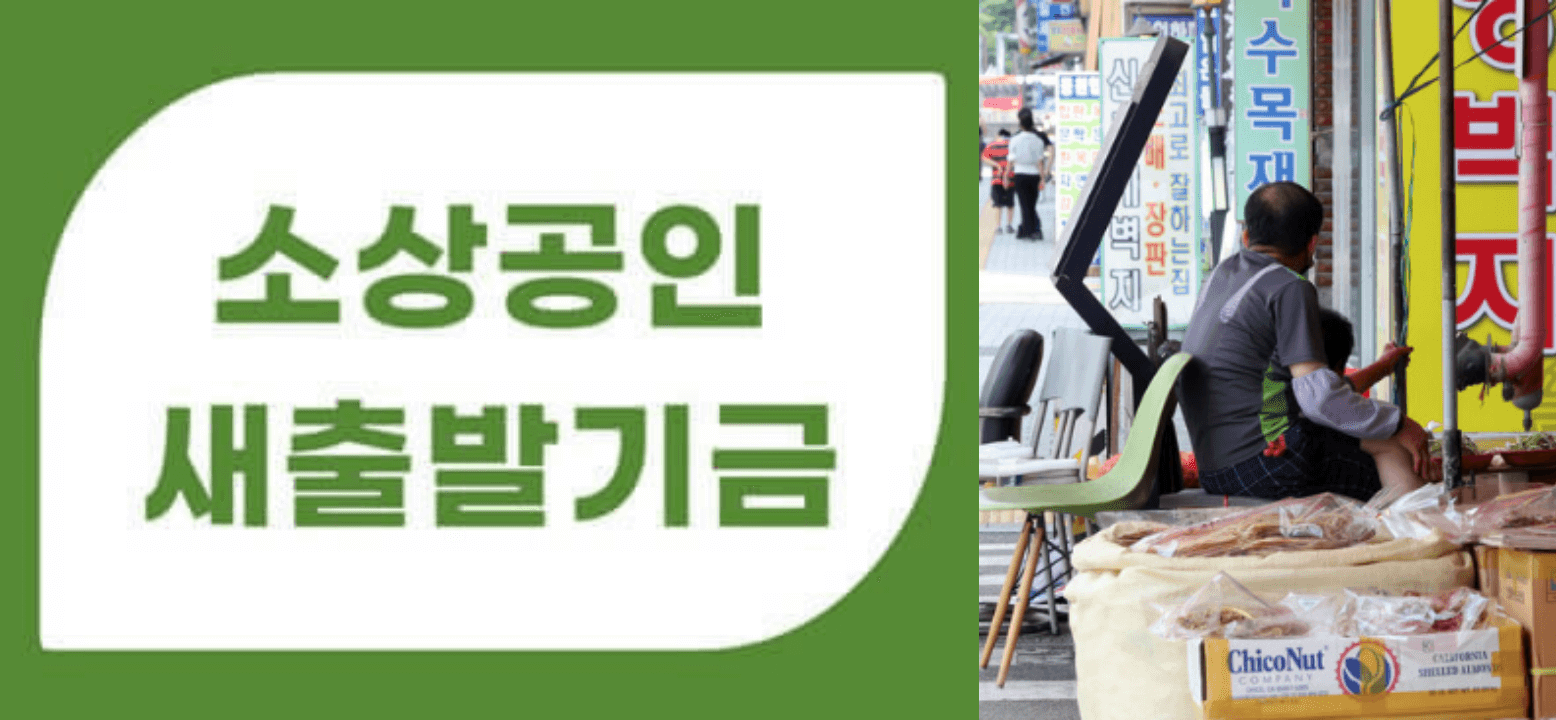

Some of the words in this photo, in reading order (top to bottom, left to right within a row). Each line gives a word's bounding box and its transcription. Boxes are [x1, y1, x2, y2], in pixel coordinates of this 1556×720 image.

[1245, 0, 1299, 193] 수목재
[214, 203, 763, 329] 소상공인
[145, 399, 837, 528] 새출발기금
[1227, 647, 1324, 674] ChicoNut
[1238, 674, 1313, 685] COMPANY
[1432, 651, 1488, 663] CALIFORNIA
